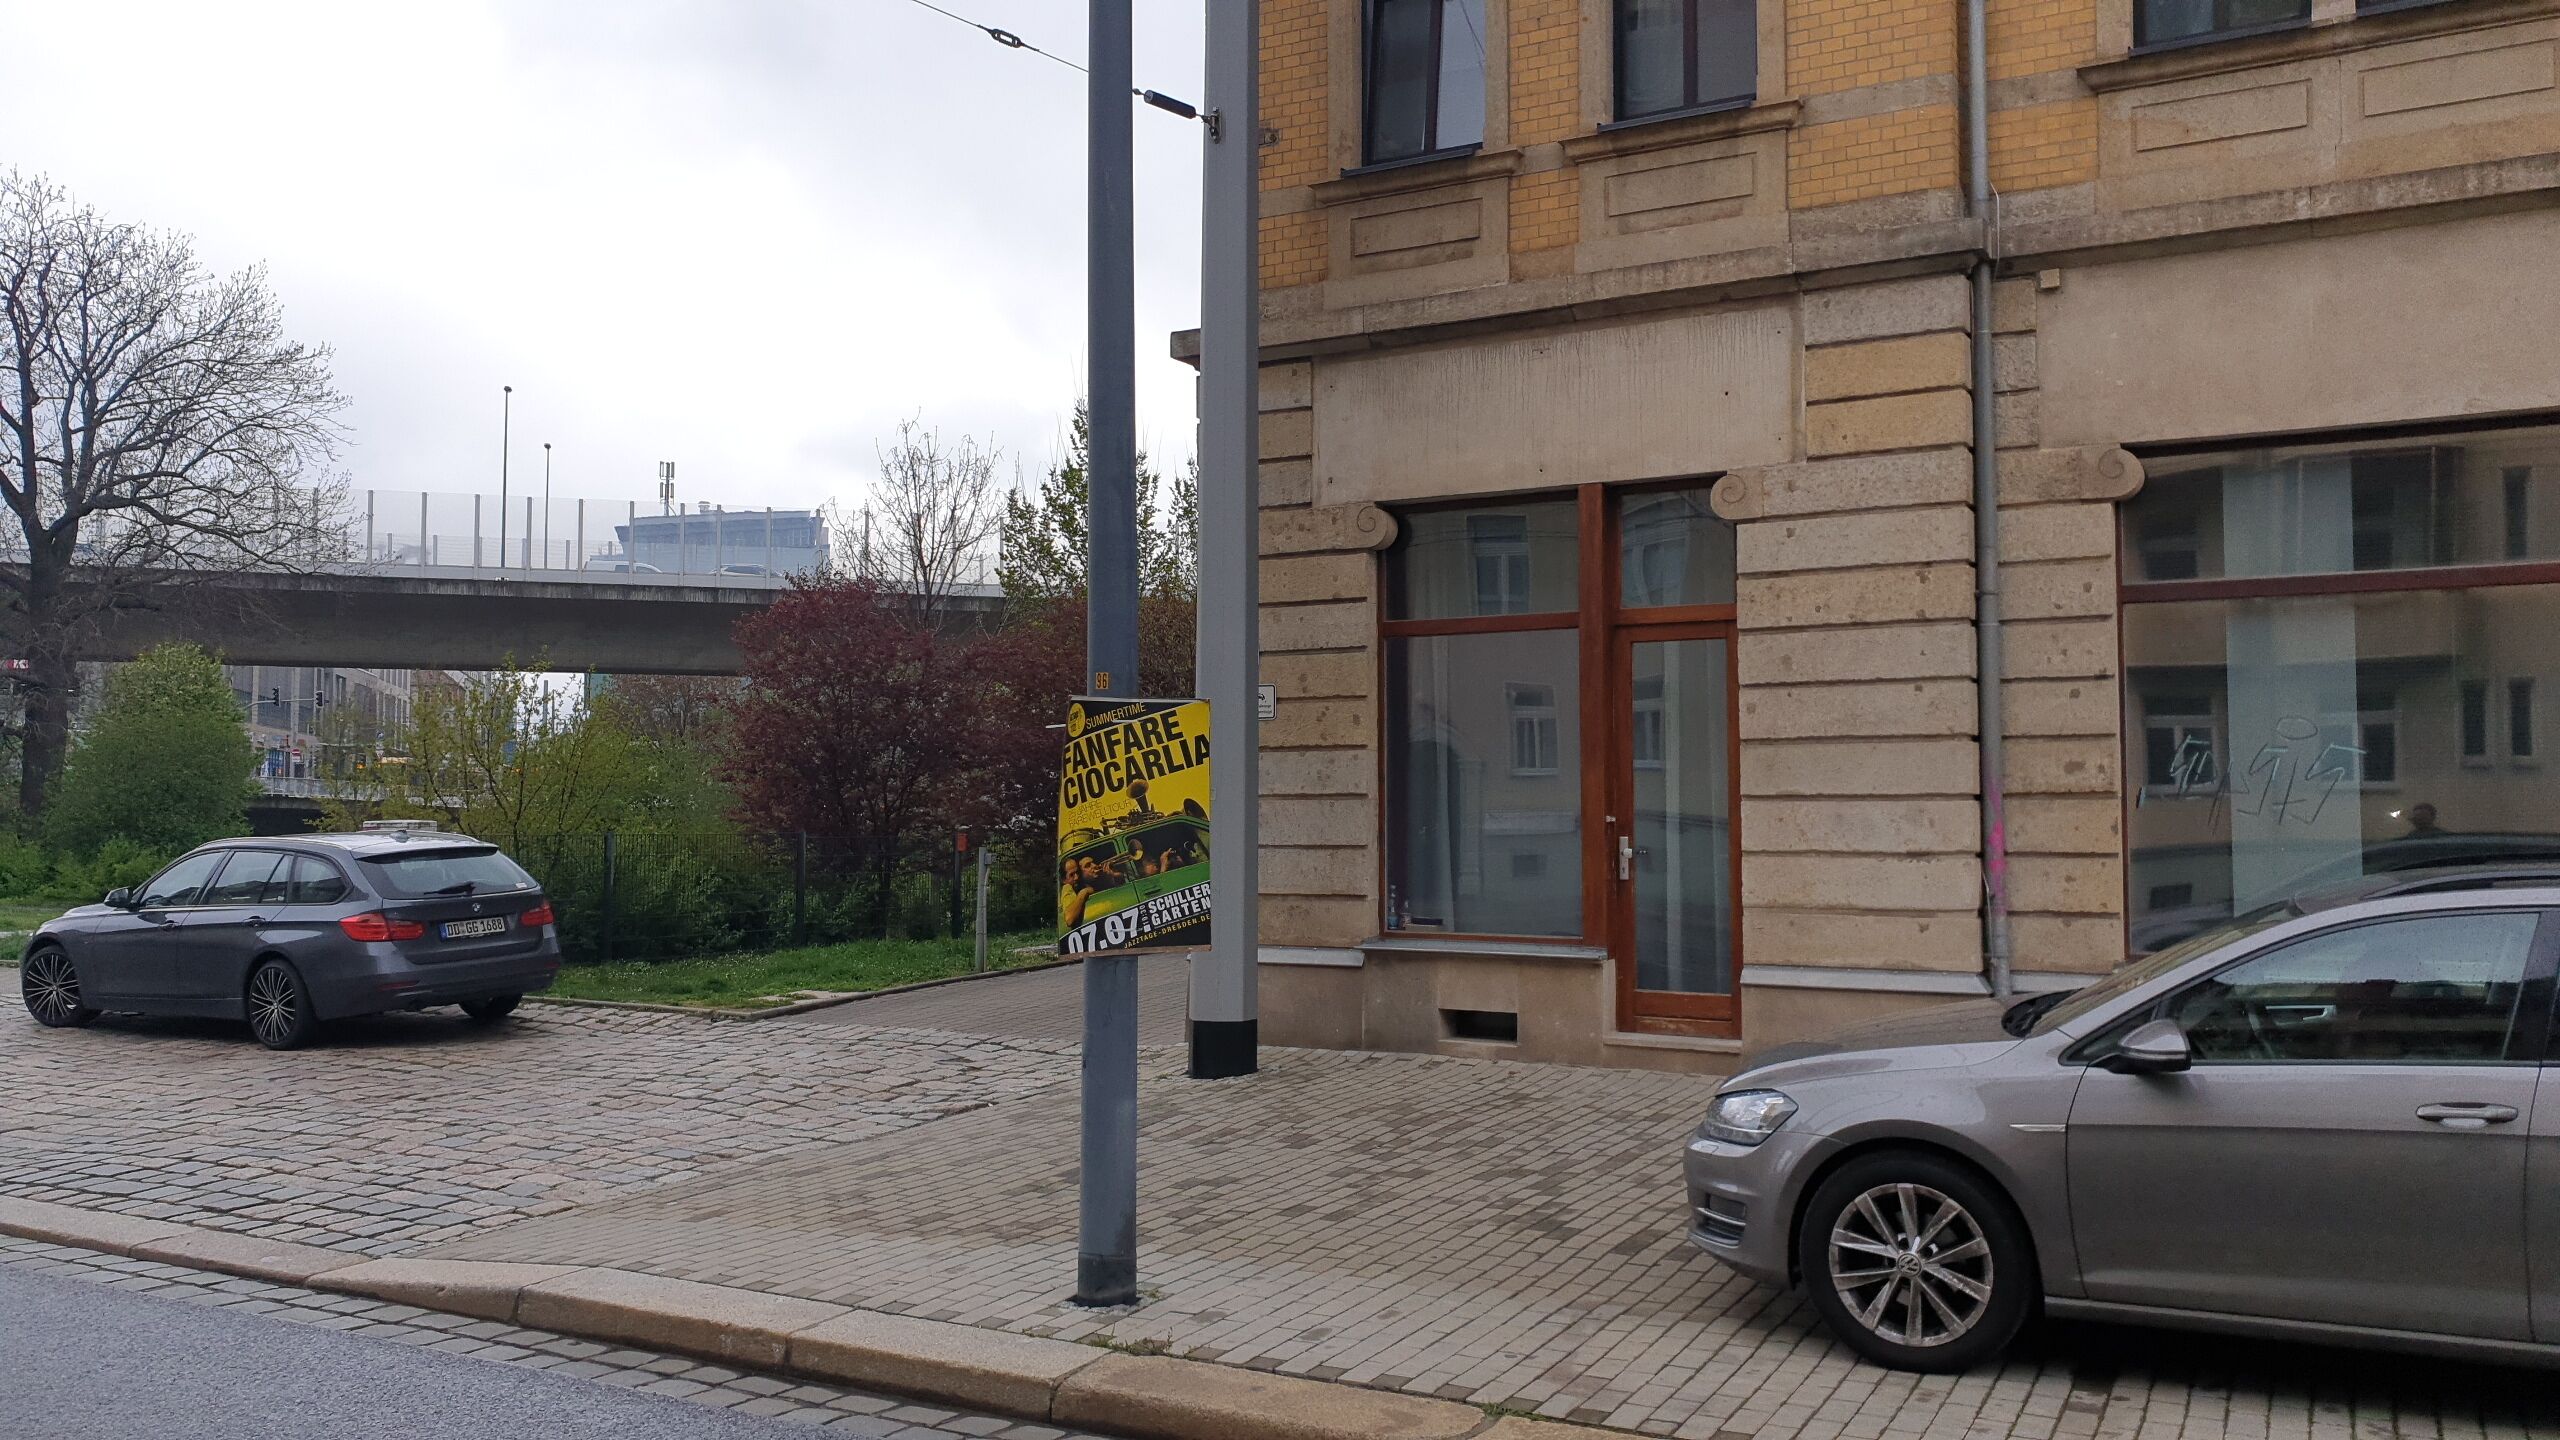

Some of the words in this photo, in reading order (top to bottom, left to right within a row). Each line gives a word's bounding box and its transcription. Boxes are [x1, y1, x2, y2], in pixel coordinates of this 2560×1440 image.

[1085, 702, 1147, 730] SUMMERTIME
[1063, 709, 1184, 778] FANFARE
[1063, 733, 1210, 809] CIOCARLIA
[1148, 883, 1210, 914] SCHILLER
[1151, 896, 1211, 926] GARTEN
[447, 924, 460, 936] DD
[466, 921, 479, 933] GG
[1124, 913, 1211, 949] JAZZTAGE-DRESDEN.DE
